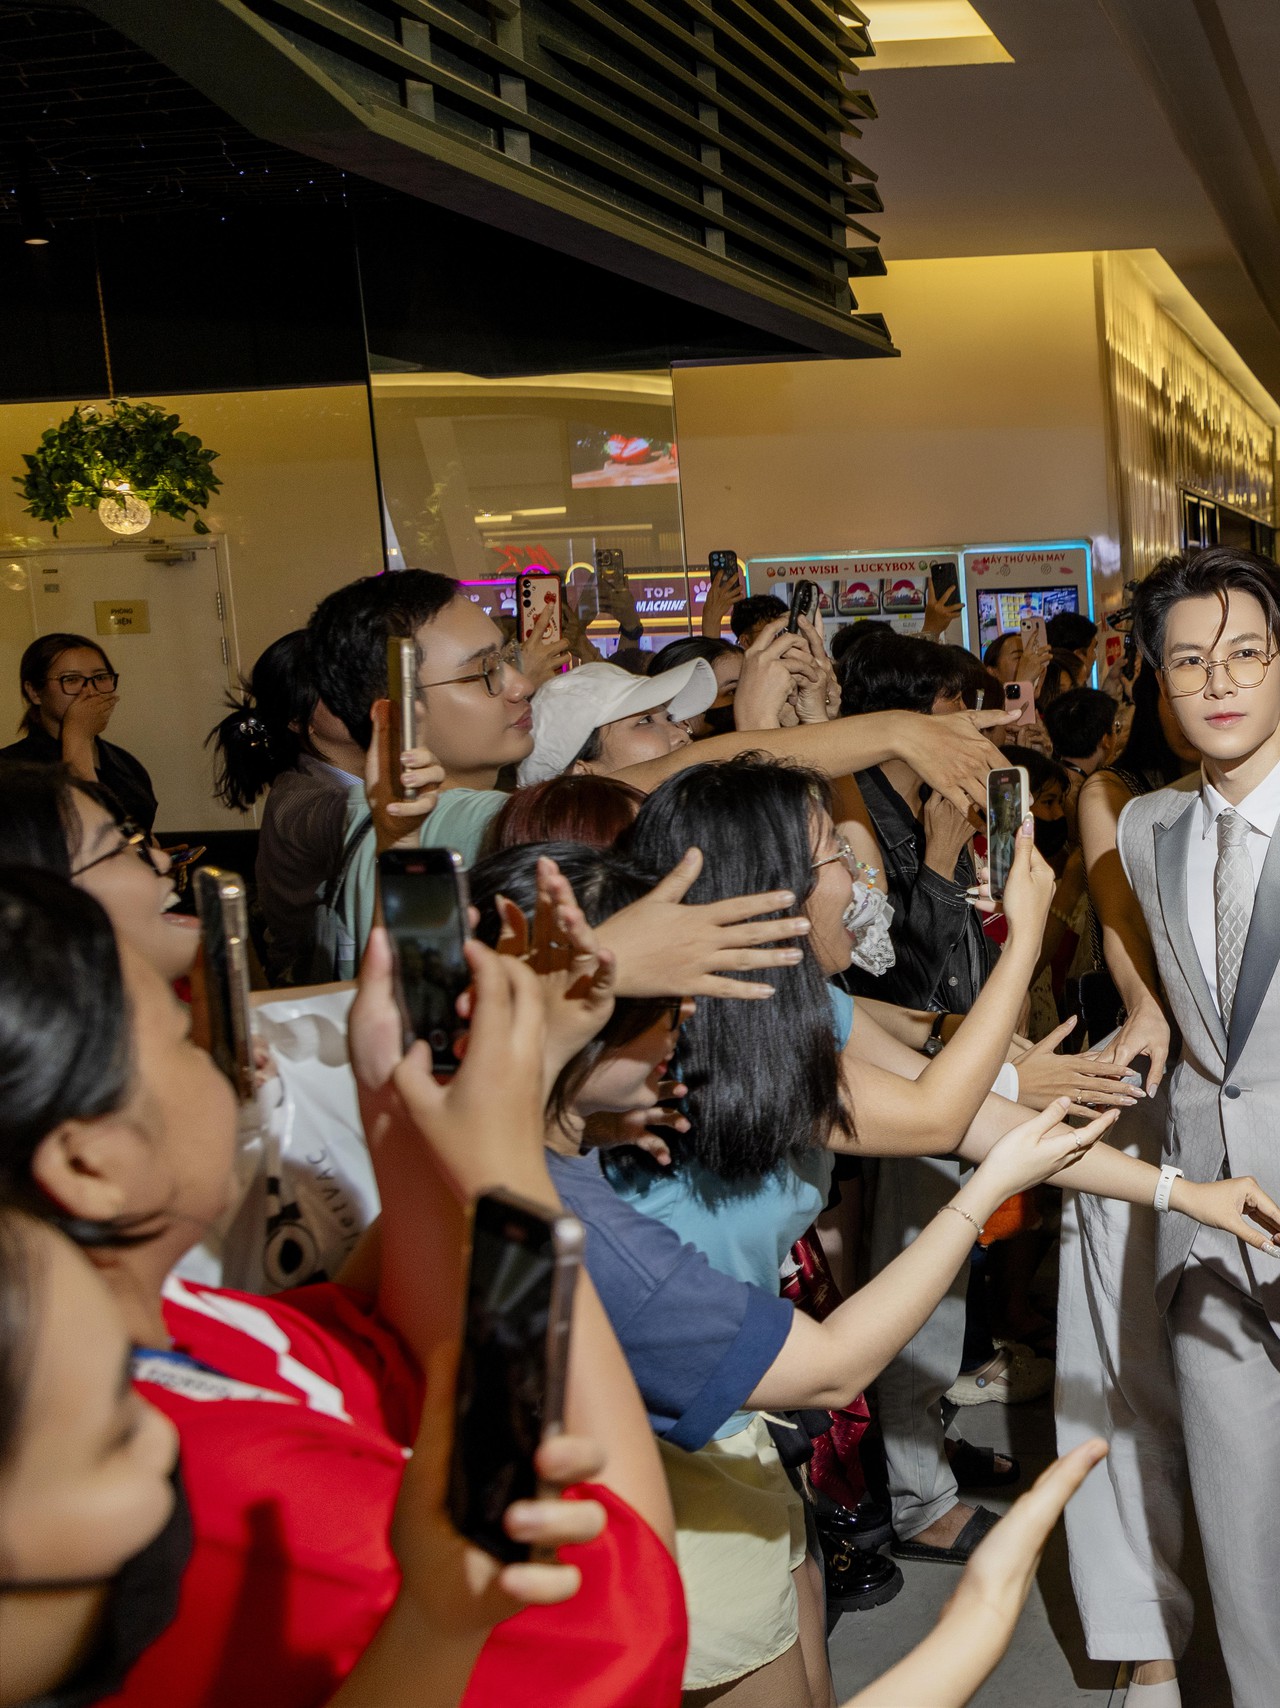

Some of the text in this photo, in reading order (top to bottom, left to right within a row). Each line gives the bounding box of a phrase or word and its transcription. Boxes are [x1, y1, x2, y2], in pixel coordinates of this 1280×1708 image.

[1046, 552, 1066, 562] MAY
[789, 566, 806, 575] MY
[809, 565, 839, 575] WISH
[854, 561, 915, 573] LUCKYBOX
[644, 586, 674, 598] TOP
[635, 599, 687, 612] MACHINE
